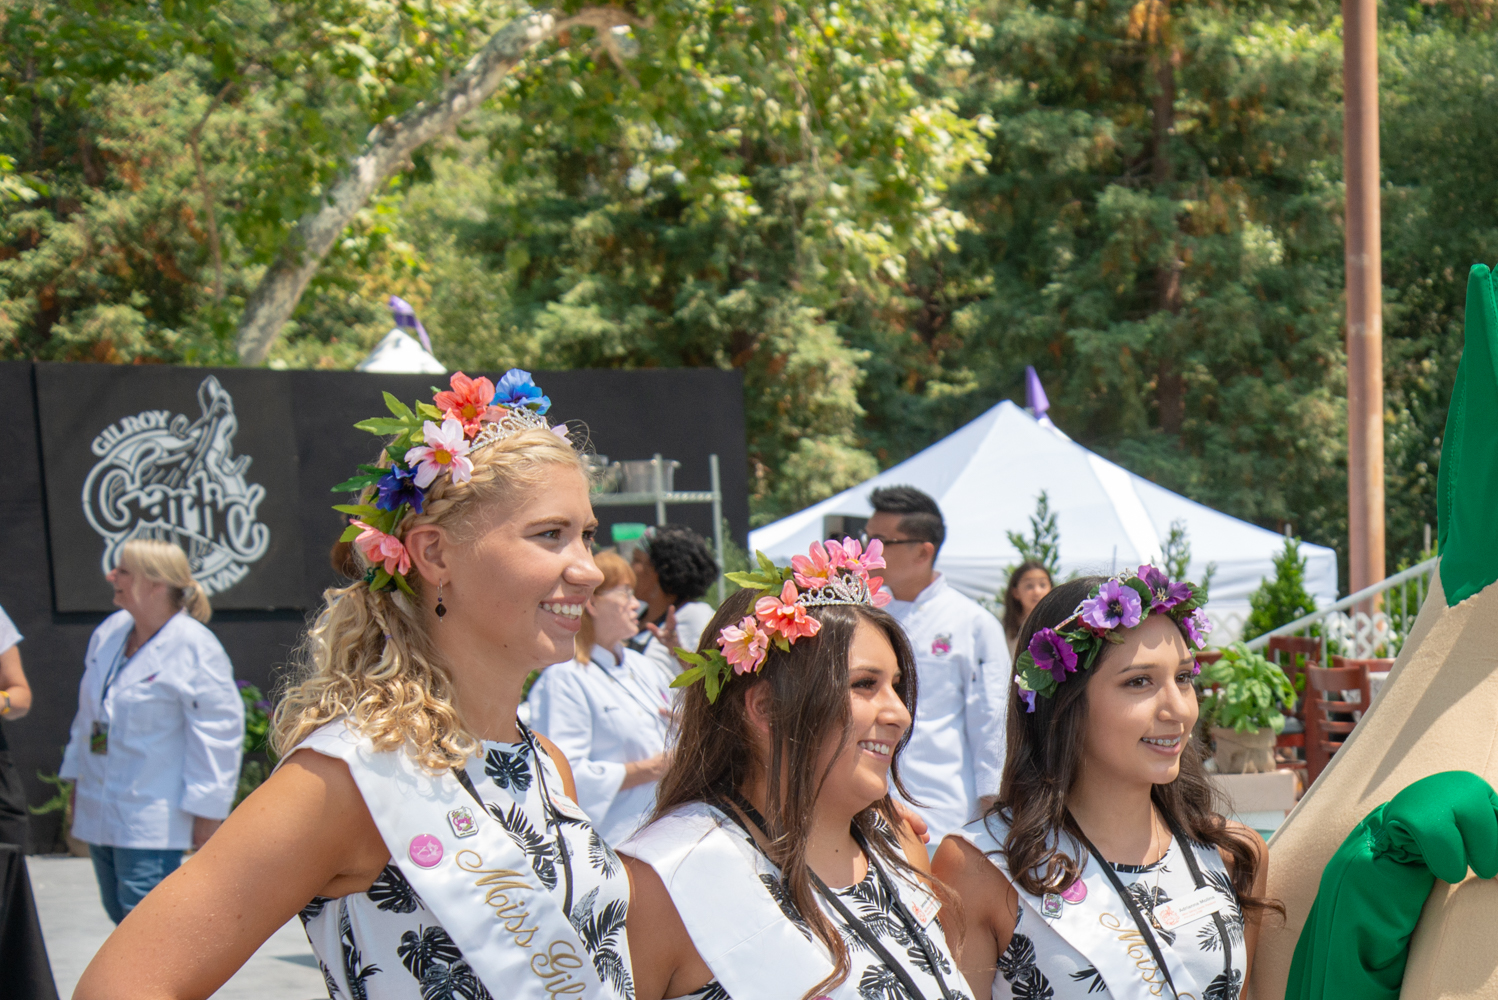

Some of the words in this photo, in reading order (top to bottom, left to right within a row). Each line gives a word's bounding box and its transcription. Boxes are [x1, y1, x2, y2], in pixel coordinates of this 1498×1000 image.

[91, 410, 171, 456] GILROY
[456, 849, 538, 948] Miss
[1099, 912, 1163, 997] Miss
